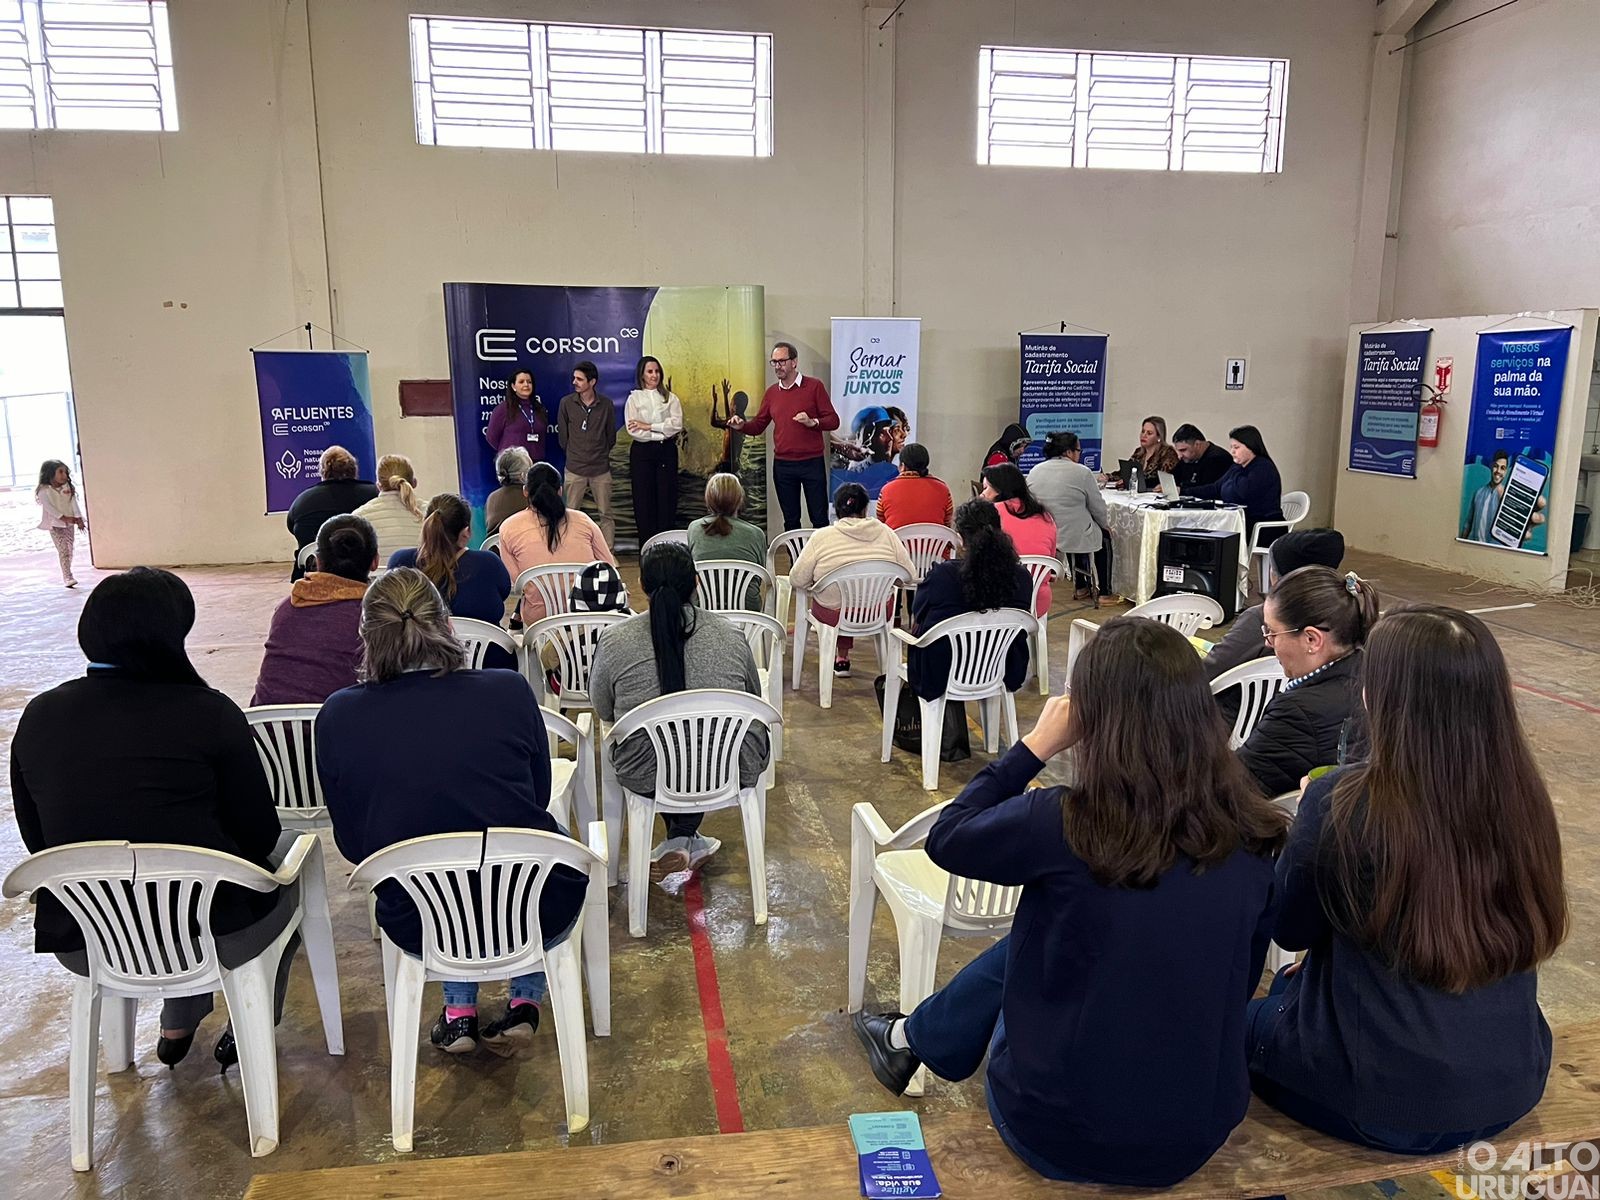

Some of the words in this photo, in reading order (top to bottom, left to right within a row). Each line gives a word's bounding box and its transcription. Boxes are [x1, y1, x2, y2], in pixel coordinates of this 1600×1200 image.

[1502, 343, 1540, 353] Nossos
[850, 346, 906, 373] Somar
[1364, 357, 1389, 374] Tarifa
[1391, 357, 1421, 371] Social
[1491, 356, 1534, 370] serviços
[1537, 357, 1551, 367] na
[859, 370, 903, 379] EVOLUIR
[1025, 360, 1061, 377] Tarifa
[1064, 360, 1098, 373] Social
[480, 377, 508, 390] Nos
[1494, 370, 1526, 385] palma
[1529, 370, 1542, 382] da
[843, 381, 900, 396] JUNTOS
[1494, 387, 1511, 396] sua
[1514, 384, 1541, 396] mão.
[272, 406, 354, 420] AFLUENTES
